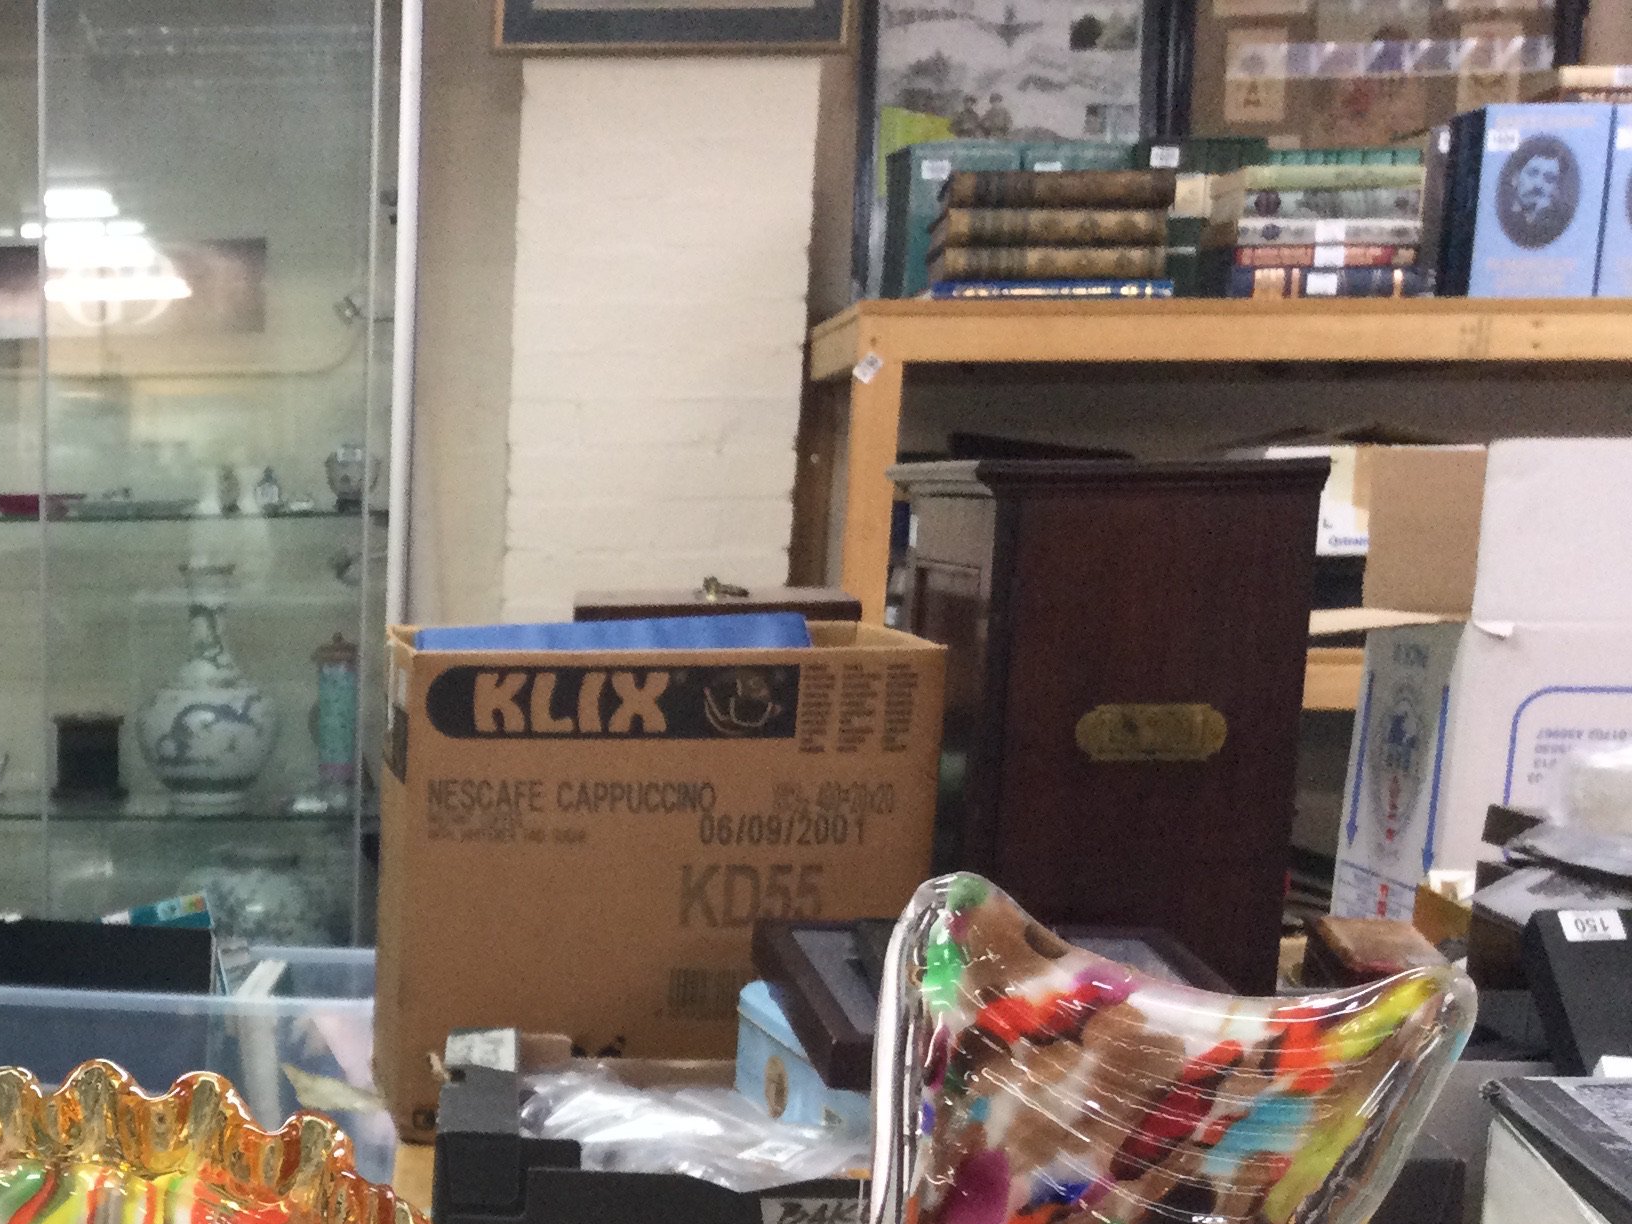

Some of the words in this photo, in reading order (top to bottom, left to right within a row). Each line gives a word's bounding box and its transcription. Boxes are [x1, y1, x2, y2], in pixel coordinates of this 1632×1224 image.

[473, 672, 670, 733] KLIX
[426, 779, 544, 812] NESCAFE
[556, 781, 717, 814] CAPPUCCINO
